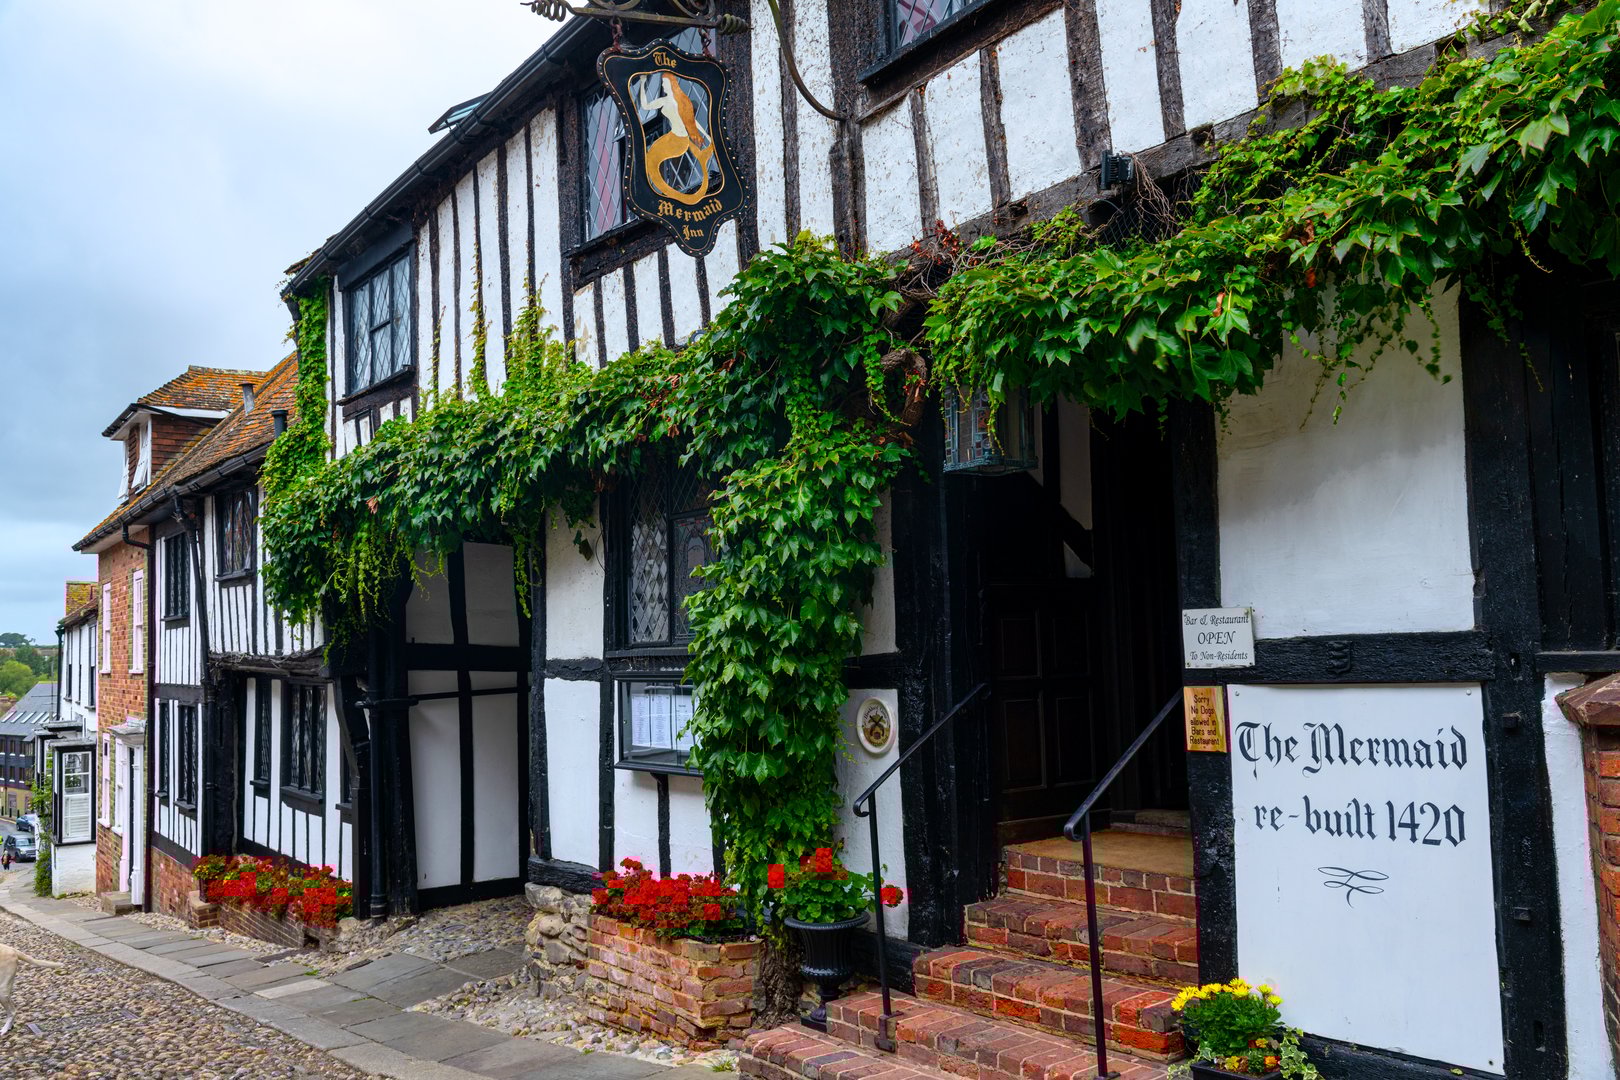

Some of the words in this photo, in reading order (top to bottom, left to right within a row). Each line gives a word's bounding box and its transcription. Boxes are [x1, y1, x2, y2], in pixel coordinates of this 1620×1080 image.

[652, 51, 677, 68] The
[657, 199, 723, 223] Mermaid
[682, 224, 705, 241] Inn
[1184, 615, 1197, 626] Bar
[1200, 614, 1208, 626] &
[1210, 615, 1249, 626] Restaurant
[1197, 630, 1236, 645] OPEN
[1190, 651, 1198, 661] To
[1200, 650, 1248, 662] Non-Residents
[1193, 694, 1210, 705] Sorry
[1191, 706, 1198, 715] No
[1201, 705, 1215, 717] Dogs
[1190, 717, 1209, 726] allowed
[1191, 727, 1205, 736] Bars
[1207, 728, 1216, 736] and
[1190, 736, 1219, 746] Restaurant
[1235, 721, 1300, 781] The
[1302, 722, 1468, 778] Mermaid
[1254, 795, 1378, 840] re-built
[1385, 800, 1467, 848] 1420
